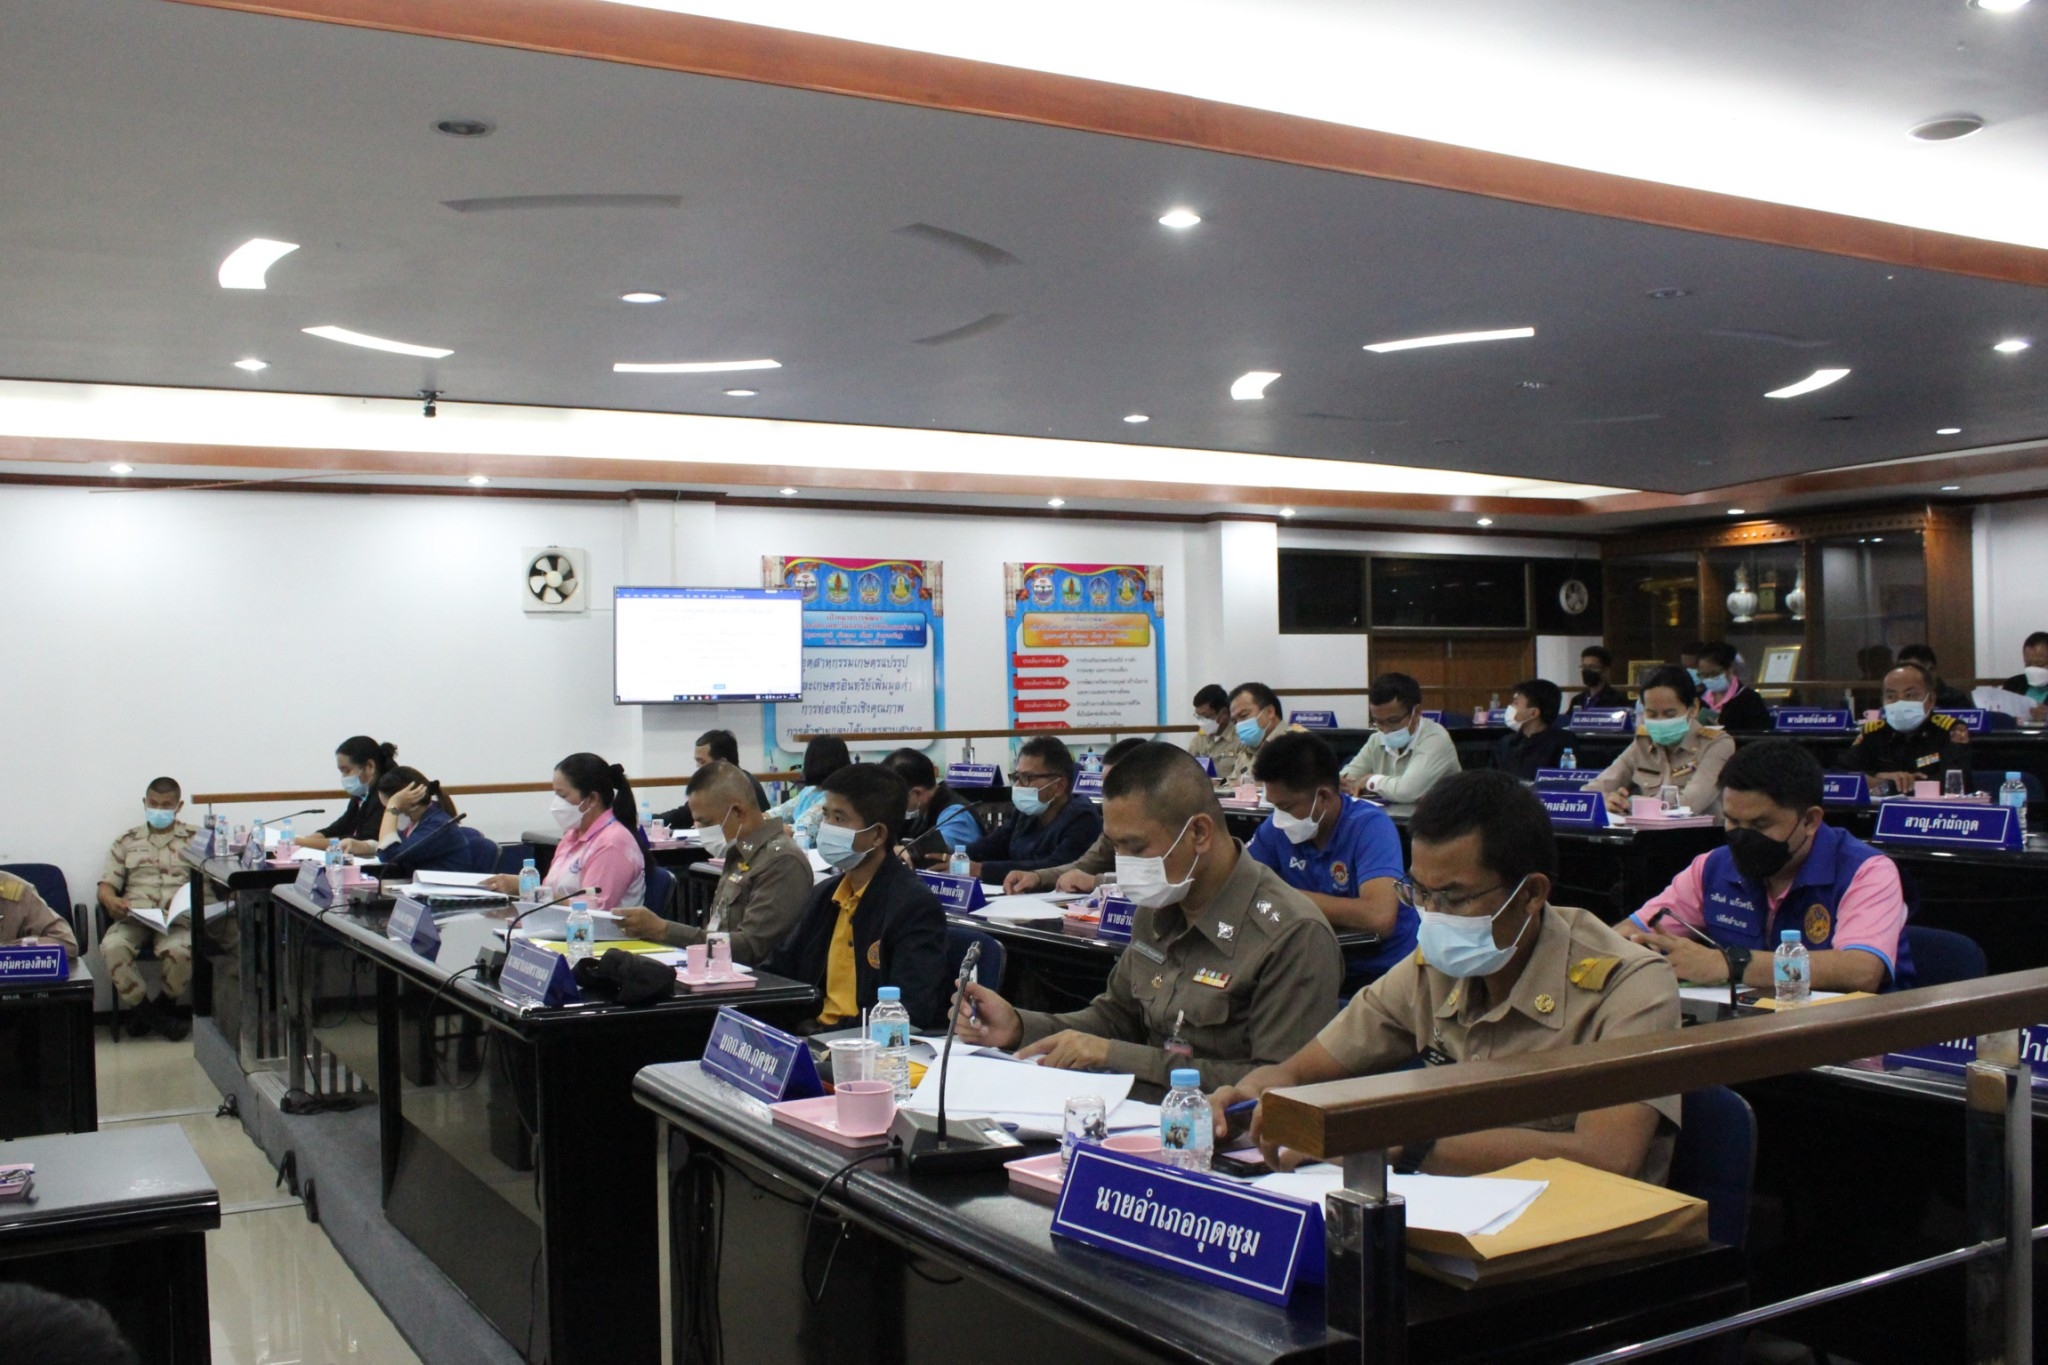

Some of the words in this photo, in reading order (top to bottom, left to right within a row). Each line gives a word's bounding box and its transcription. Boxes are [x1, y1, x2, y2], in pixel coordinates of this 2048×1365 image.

[802, 674, 912, 696] ละเกษตรอินทรีย์เพิ่มมูลค่า
[1095, 1186, 1261, 1263] นายอำเภอกุดชุม
